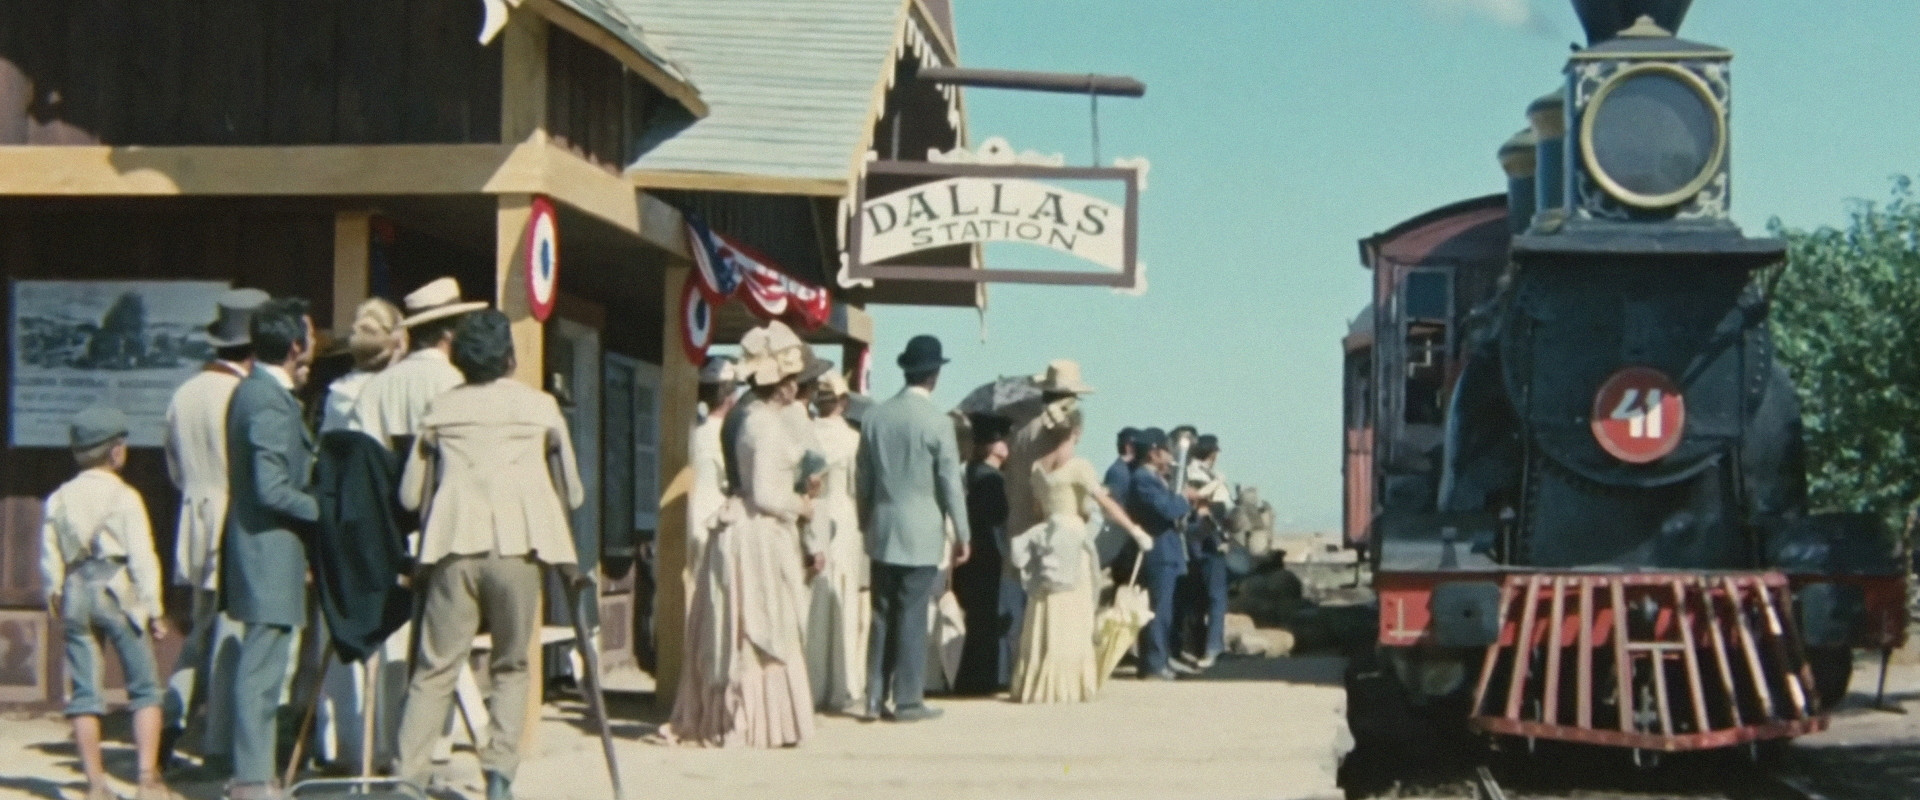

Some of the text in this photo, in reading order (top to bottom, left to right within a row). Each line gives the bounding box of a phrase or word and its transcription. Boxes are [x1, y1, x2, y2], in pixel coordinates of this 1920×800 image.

[865, 183, 1109, 236] DALLAS
[911, 219, 1077, 250] STATION
[1611, 388, 1661, 438] 41
